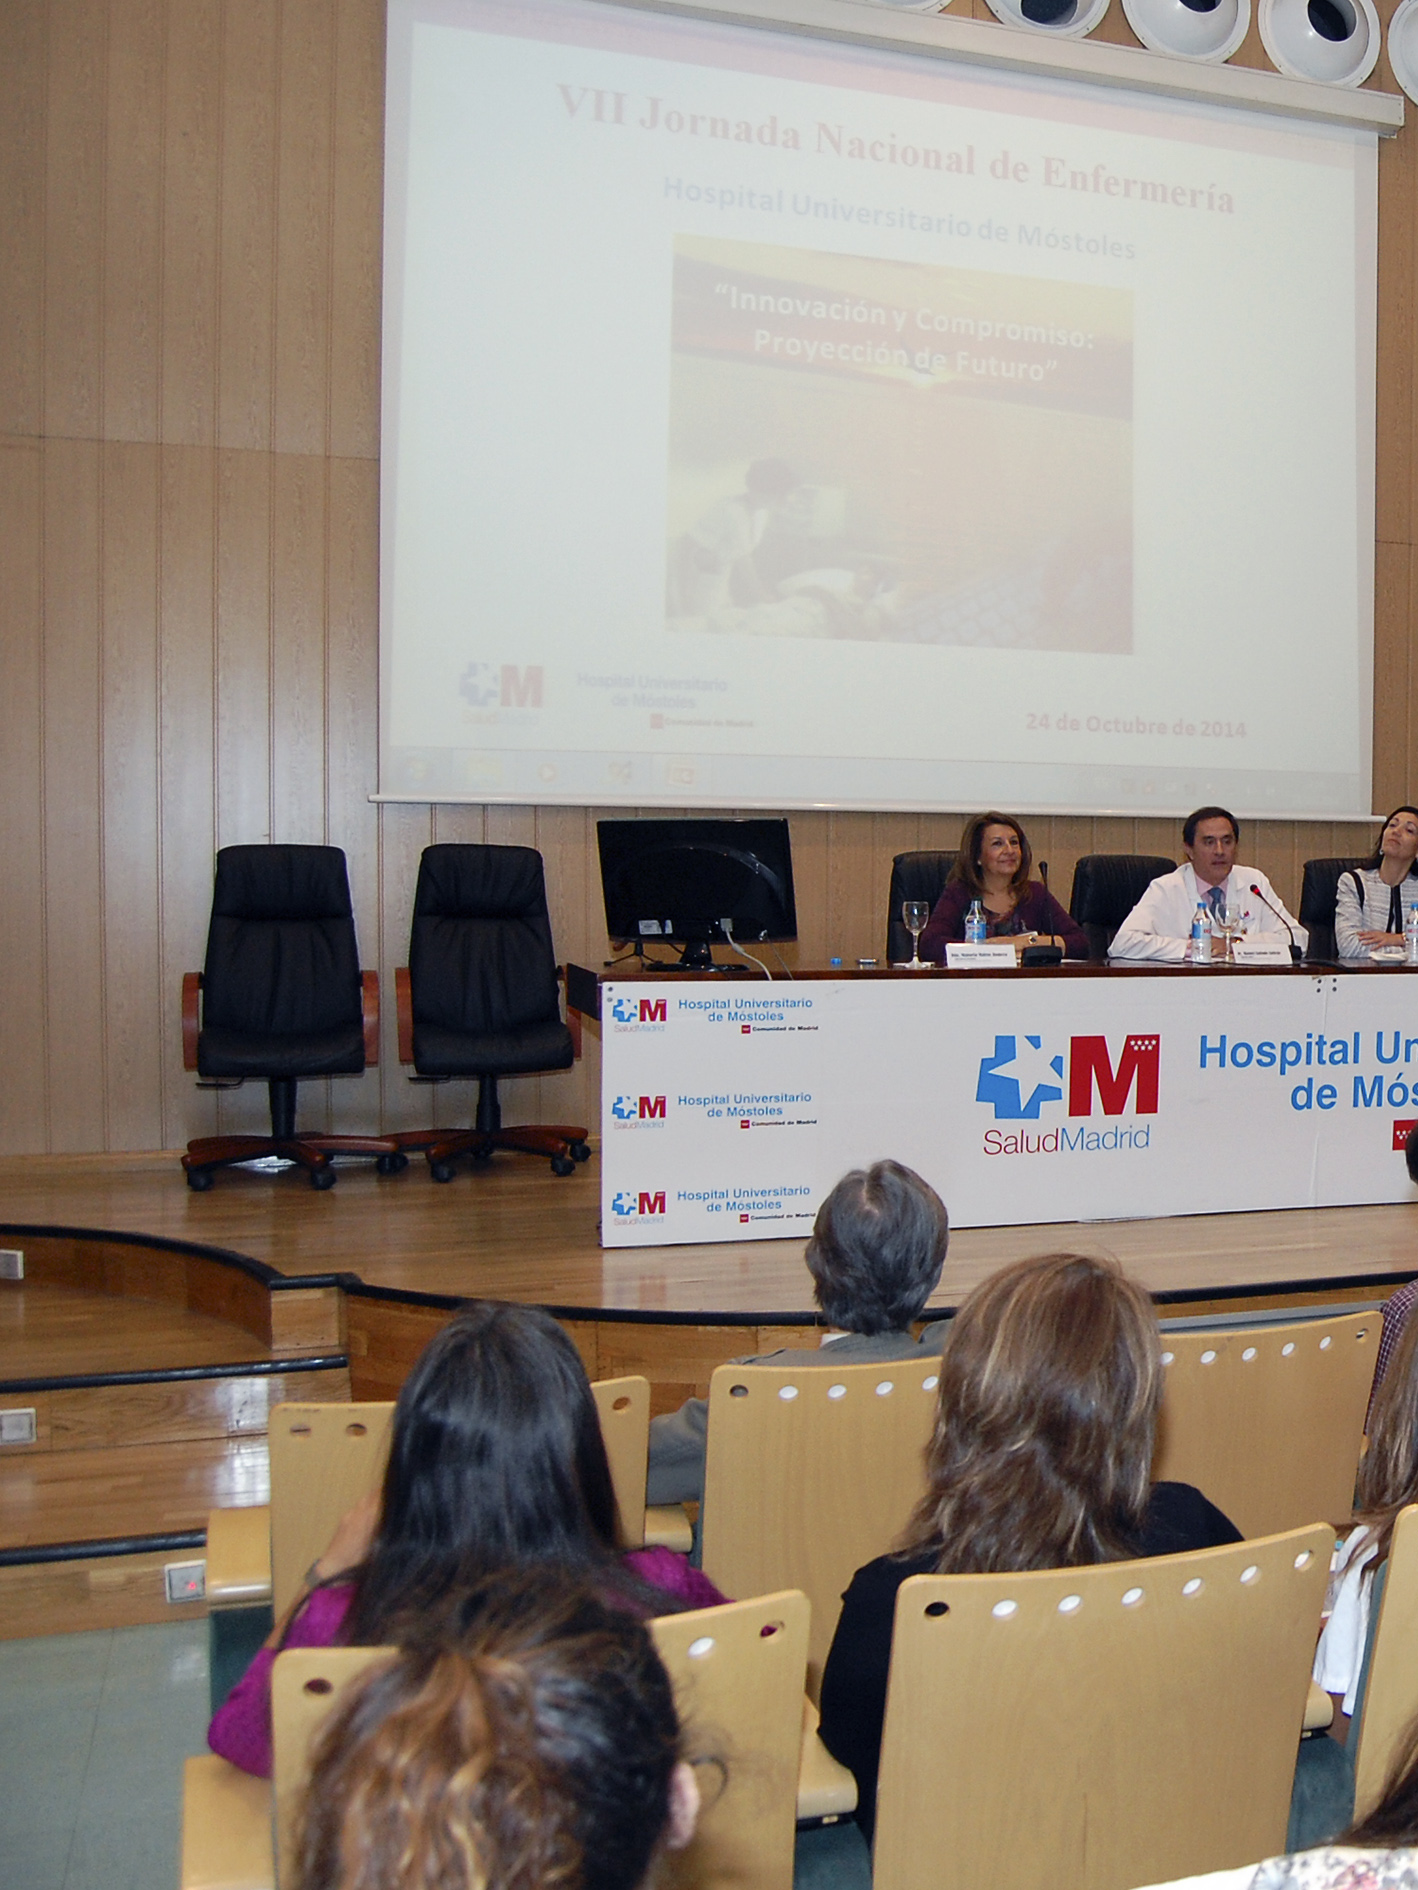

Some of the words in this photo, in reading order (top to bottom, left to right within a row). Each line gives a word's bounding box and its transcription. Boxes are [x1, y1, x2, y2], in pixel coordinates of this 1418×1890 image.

[556, 83, 626, 126] VII
[640, 96, 802, 151] Jornada
[815, 121, 976, 176] Nacional
[988, 151, 1029, 184] de
[1042, 156, 1236, 215] Enfermería
[663, 176, 784, 214] Hospital
[791, 195, 972, 239] Universitario
[977, 214, 1009, 243] de
[1017, 219, 1136, 260] Móstoles
[892, 308, 907, 332] y
[915, 307, 1096, 350] Compromiso:
[754, 329, 908, 369] Proyección
[914, 347, 947, 371] de
[500, 664, 544, 708] M
[576, 671, 635, 691] Hospital
[638, 674, 728, 693] Universitario
[611, 693, 629, 707] de
[1025, 712, 1051, 731] 24
[1056, 712, 1081, 732] de
[1086, 715, 1168, 736] Octubre
[1172, 718, 1196, 737] de
[1200, 719, 1247, 739] 2014
[639, 999, 667, 1022] M
[678, 999, 730, 1011] Hospital
[734, 999, 813, 1009] Universitario
[708, 1012, 723, 1022] de
[728, 1011, 784, 1021] Móstoles
[1200, 1032, 1360, 1076] Hospital
[1069, 1034, 1160, 1117] M
[678, 1094, 729, 1107] Hospital
[733, 1093, 812, 1105] Universitario
[1290, 1077, 1338, 1111] de
[639, 1096, 666, 1119] M
[707, 1108, 722, 1117] de
[727, 1106, 783, 1117] Móstoles
[983, 1124, 1151, 1155] SaludMadrid
[638, 1191, 666, 1215] M
[677, 1190, 728, 1202] Hospital
[733, 1187, 810, 1199] Universitario
[706, 1202, 722, 1212] de
[726, 1200, 782, 1211] Móstoles
